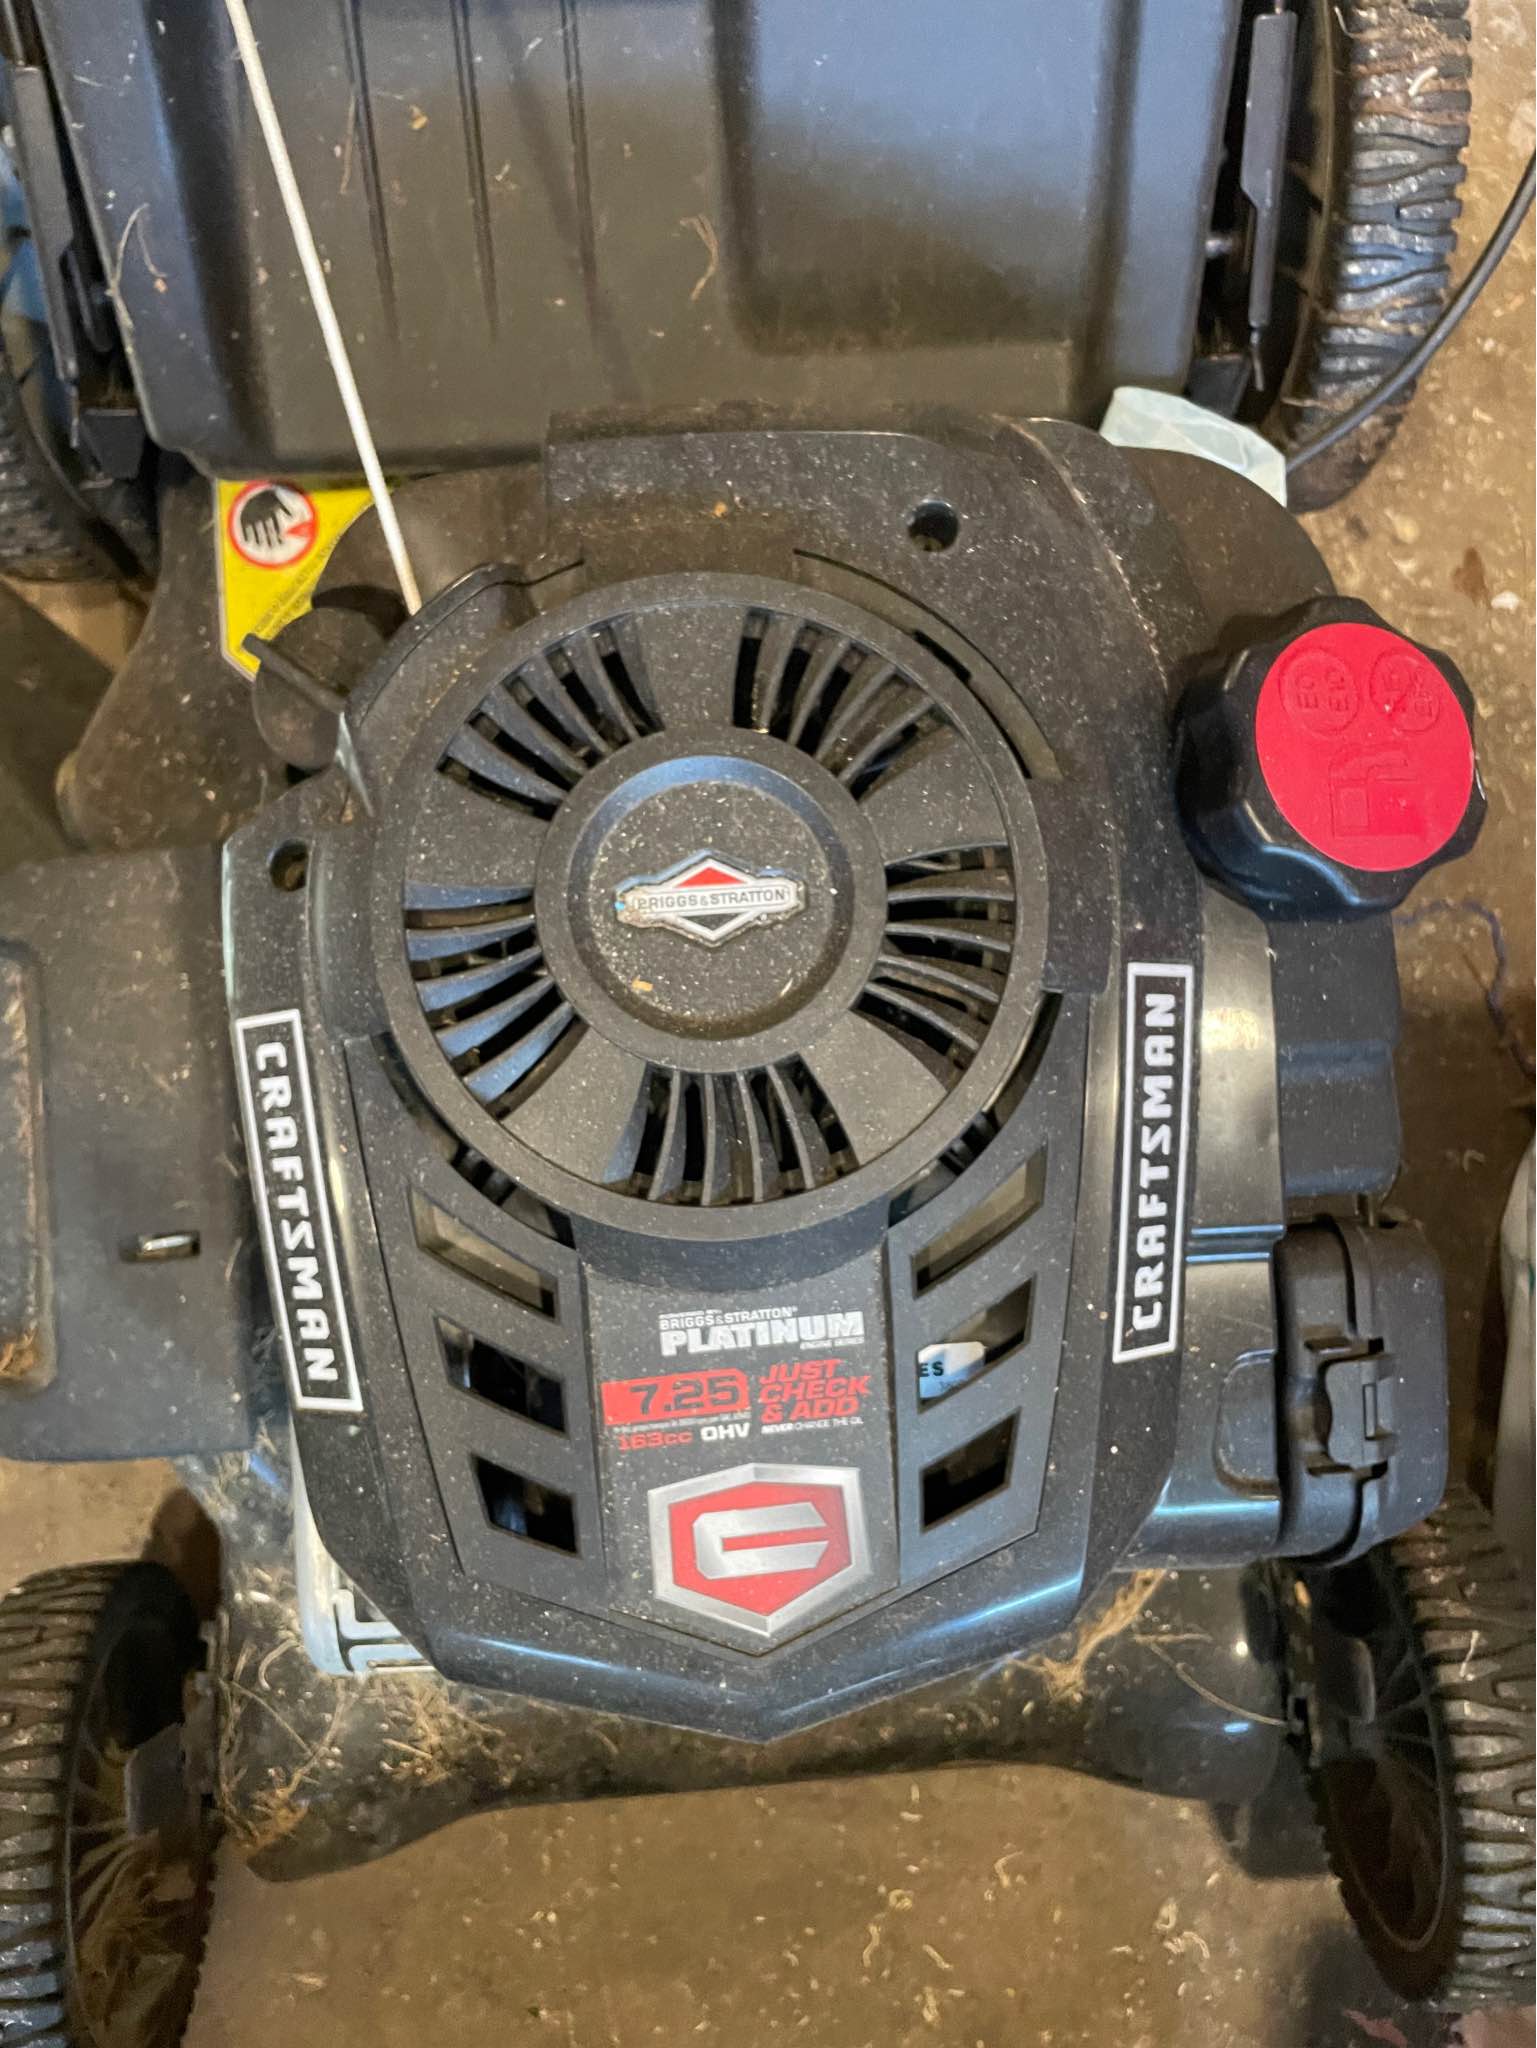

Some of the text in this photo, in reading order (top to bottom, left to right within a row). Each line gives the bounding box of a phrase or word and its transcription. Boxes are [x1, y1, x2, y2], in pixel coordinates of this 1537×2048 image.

[1132, 992, 1178, 1331] CRAFTSMAN
[256, 1041, 339, 1383] CRAFTSMAN
[660, 1311, 866, 1357] PLATINUM
[759, 1358, 844, 1385] JUST
[631, 1375, 741, 1415] 7.25
[758, 1375, 872, 1404] CHECK
[760, 1404, 784, 1424] &
[791, 1396, 861, 1419] ADD
[700, 1422, 752, 1442] OHV
[761, 1422, 795, 1435] NEVER
[833, 1418, 848, 1428] THE
